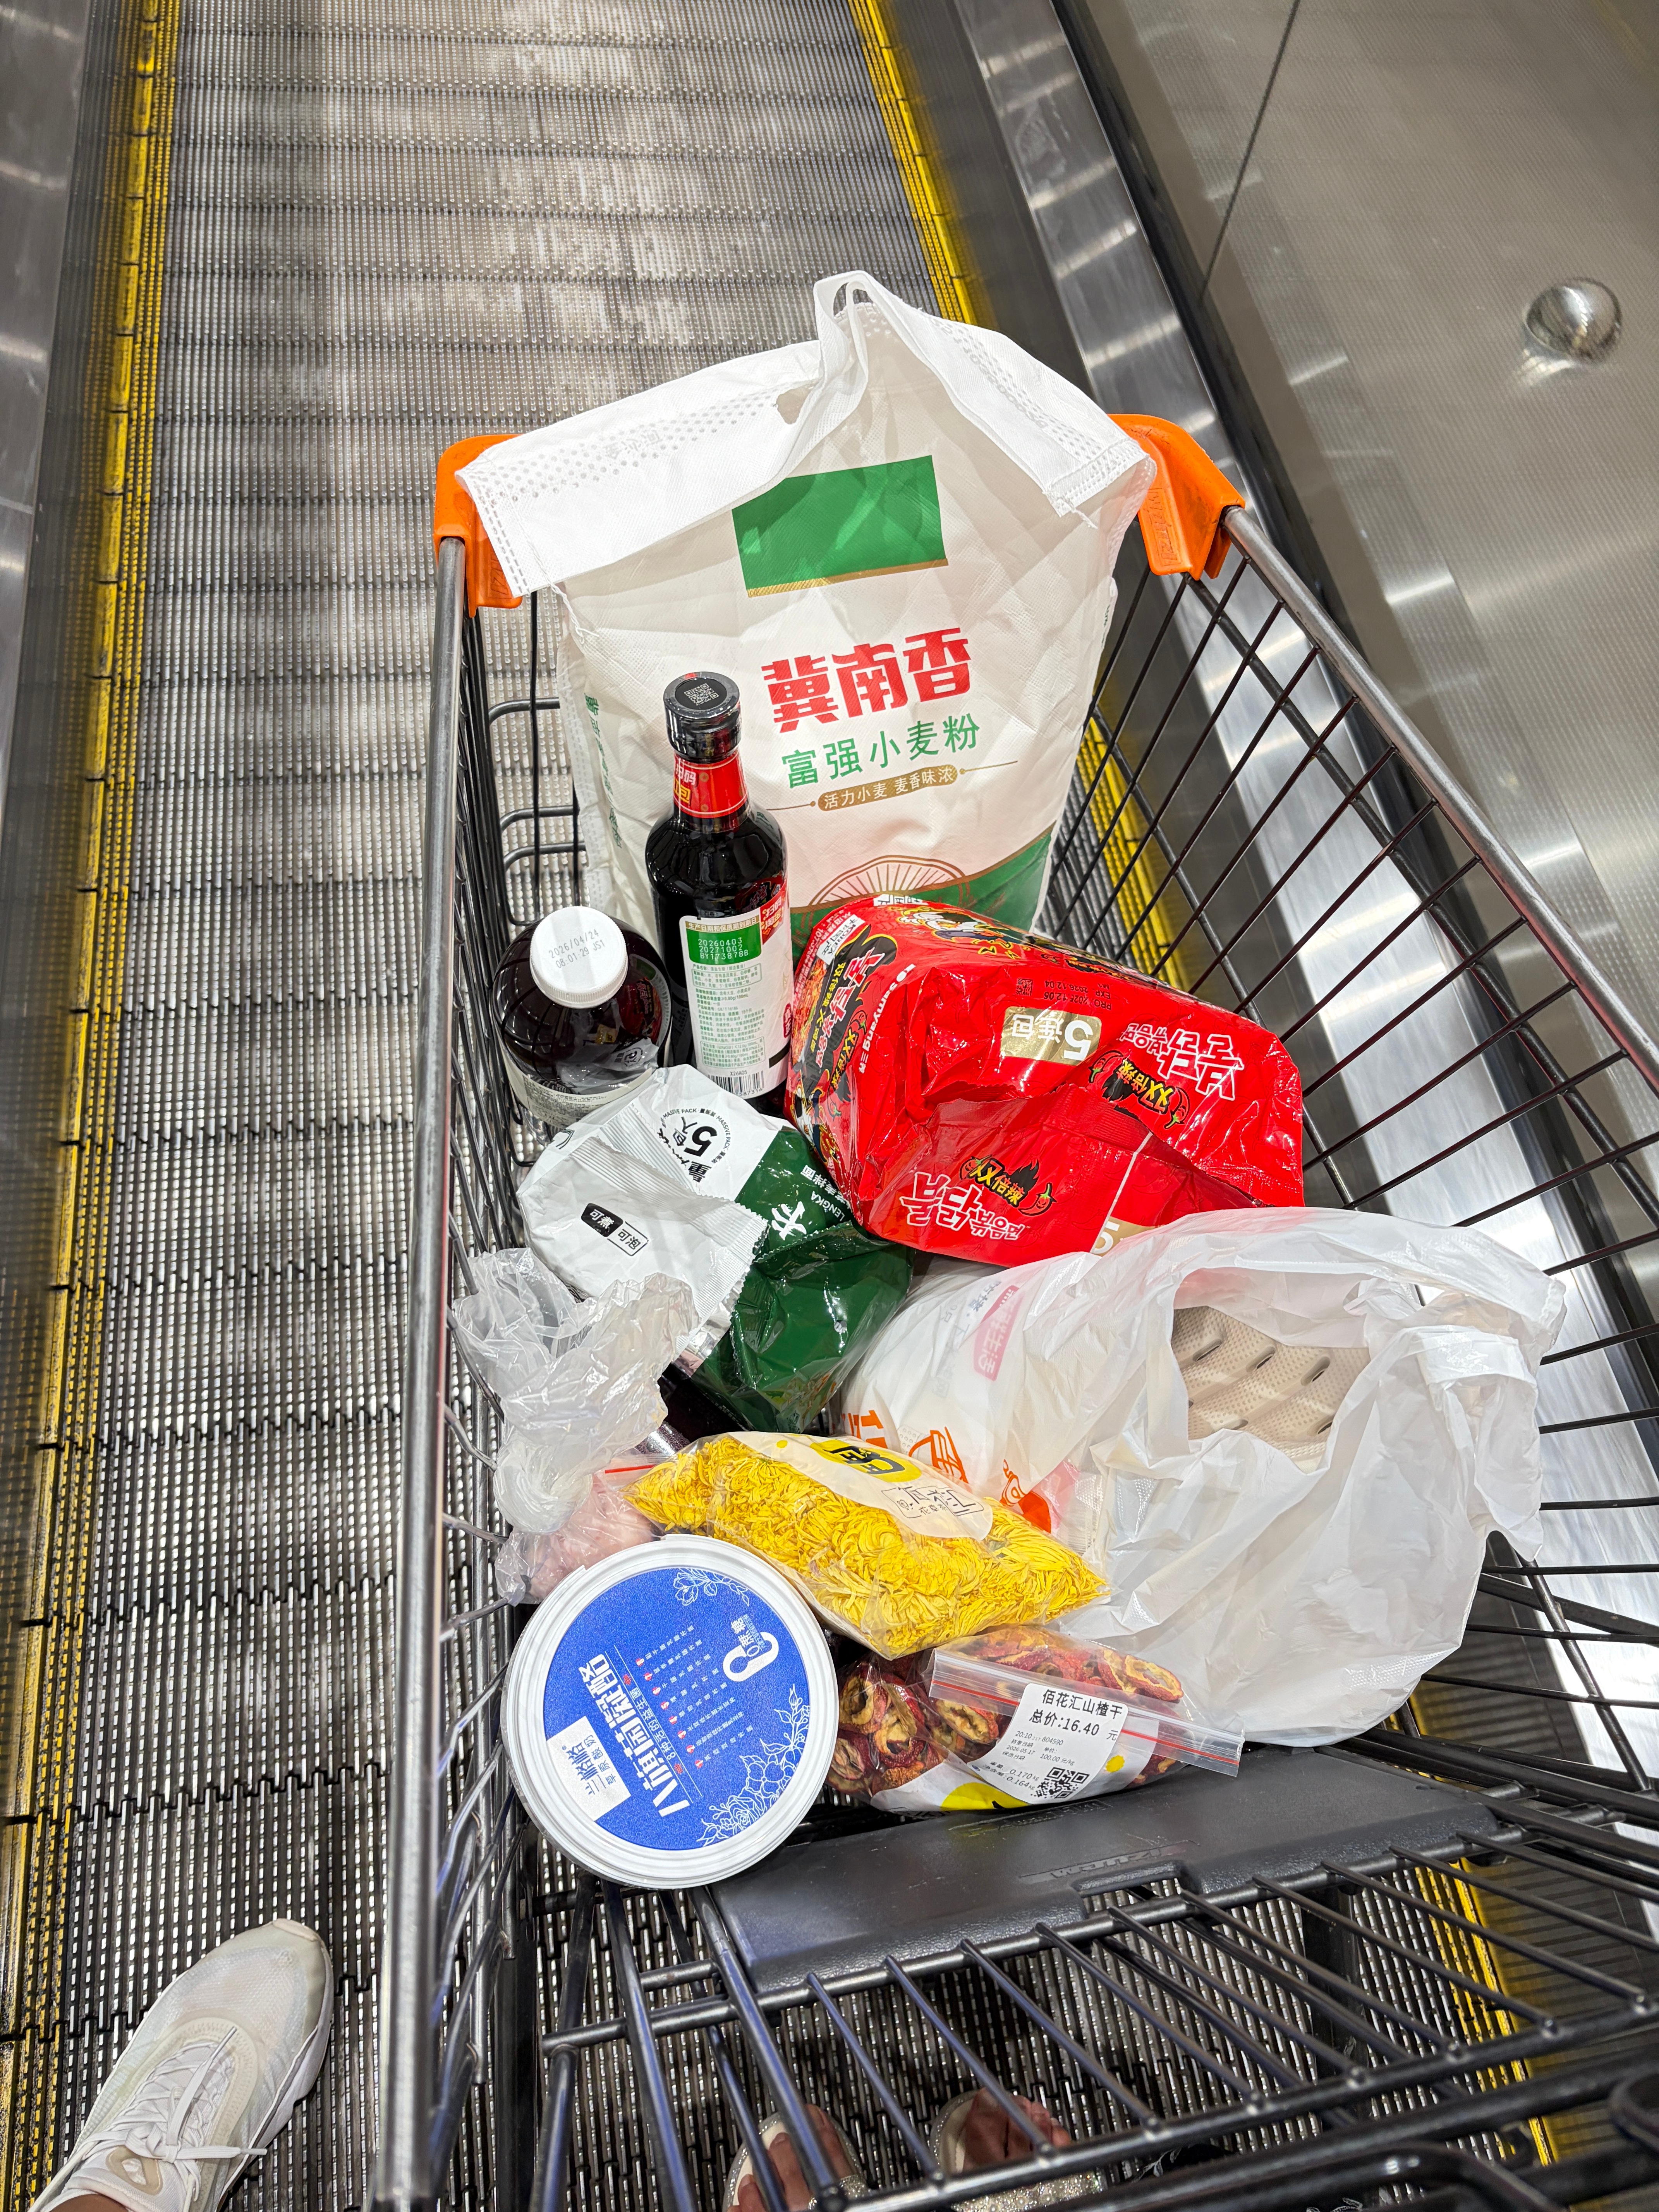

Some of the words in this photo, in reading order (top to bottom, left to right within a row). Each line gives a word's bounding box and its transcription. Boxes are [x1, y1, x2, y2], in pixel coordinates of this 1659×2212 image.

[761, 627, 971, 733] 冀南香
[781, 713, 980, 789] 富强小麦粉
[824, 783, 888, 811] 活力小麦
[895, 766, 955, 793] 麦香味浓
[549, 929, 599, 959] 2026/04/24
[698, 937, 743, 947] 20260403
[699, 944, 743, 953] 20271002
[827, 924, 856, 953] KOREA
[555, 947, 590, 969] 08:01:29
[1012, 1014, 1094, 1062] 5连包
[830, 1029, 859, 1087] 双倍辣
[1115, 1058, 1174, 1114] 双倍辣
[716, 1115, 731, 1136] MASSIVE
[970, 1159, 1025, 1205] 双倍辣
[589, 1207, 615, 1230] 可煮
[810, 1190, 845, 1223] LENGKA
[899, 1171, 1025, 1241] 불닭볶음면
[618, 1228, 641, 1251] 可泡
[731, 1616, 759, 1658] 0蔗糖
[1042, 1689, 1123, 1720] 佰花汇山楂干
[578, 1654, 690, 1817] 八旗菌凝酪
[630, 1687, 677, 1760] 8种活的益生菌
[1015, 1730, 1032, 1739] 20:10
[1042, 1736, 1064, 1746] 804590
[1029, 1708, 1100, 1736] 总价:16.40
[1106, 1729, 1120, 1741] 元
[567, 1745, 606, 1796] 兰格格
[584, 1735, 616, 1785] 草原酸奶
[1009, 1769, 1033, 1780] 0.170
[1039, 1753, 1060, 1762] 100.00
[1060, 1757, 1075, 1766] 元/kg
